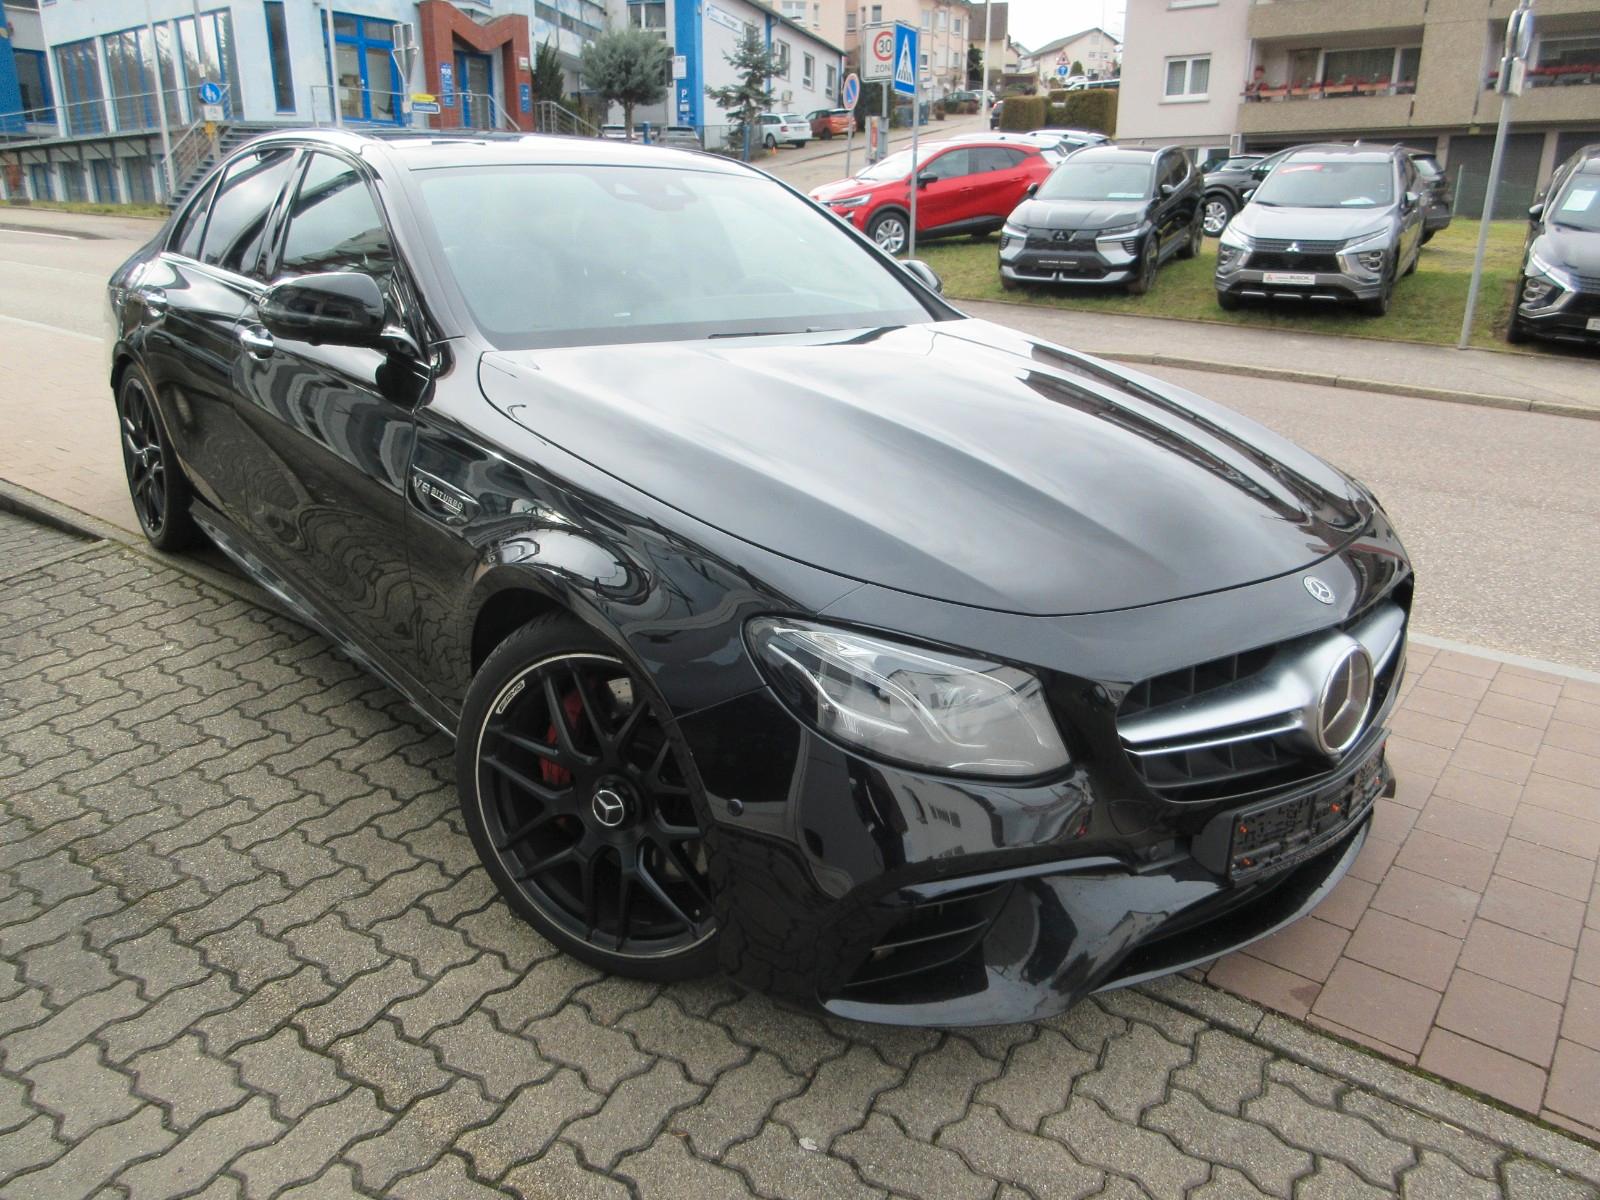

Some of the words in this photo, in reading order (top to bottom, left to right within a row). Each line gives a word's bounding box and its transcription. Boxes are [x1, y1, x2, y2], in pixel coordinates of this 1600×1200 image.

[879, 39, 892, 53] 30
[875, 64, 892, 73] ZON
[681, 88, 688, 98] P
[431, 487, 464, 510] BITURBO
